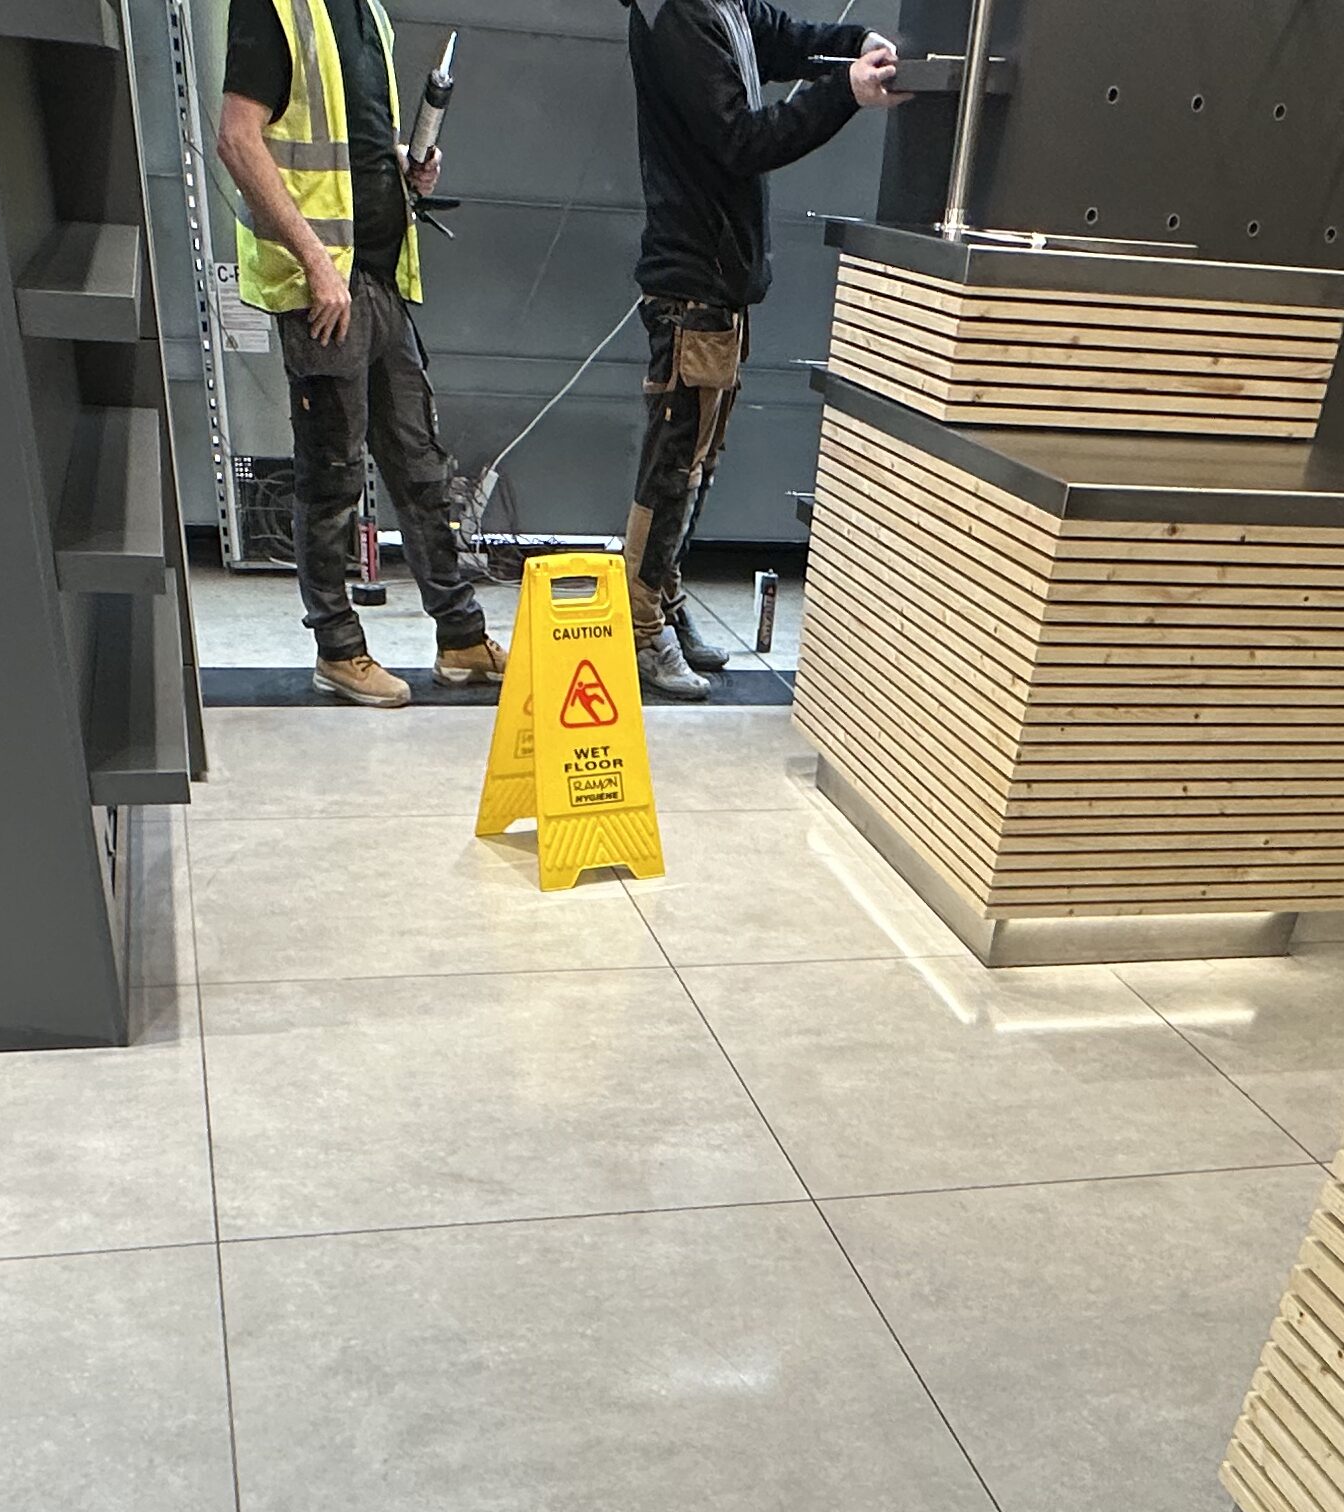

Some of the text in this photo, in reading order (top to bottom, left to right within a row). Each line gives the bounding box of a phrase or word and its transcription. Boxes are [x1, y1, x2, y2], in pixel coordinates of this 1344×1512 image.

[552, 625, 613, 641] CAUTION
[573, 745, 610, 760] WET
[564, 758, 624, 773] FLOOR
[573, 776, 618, 791] RAMON
